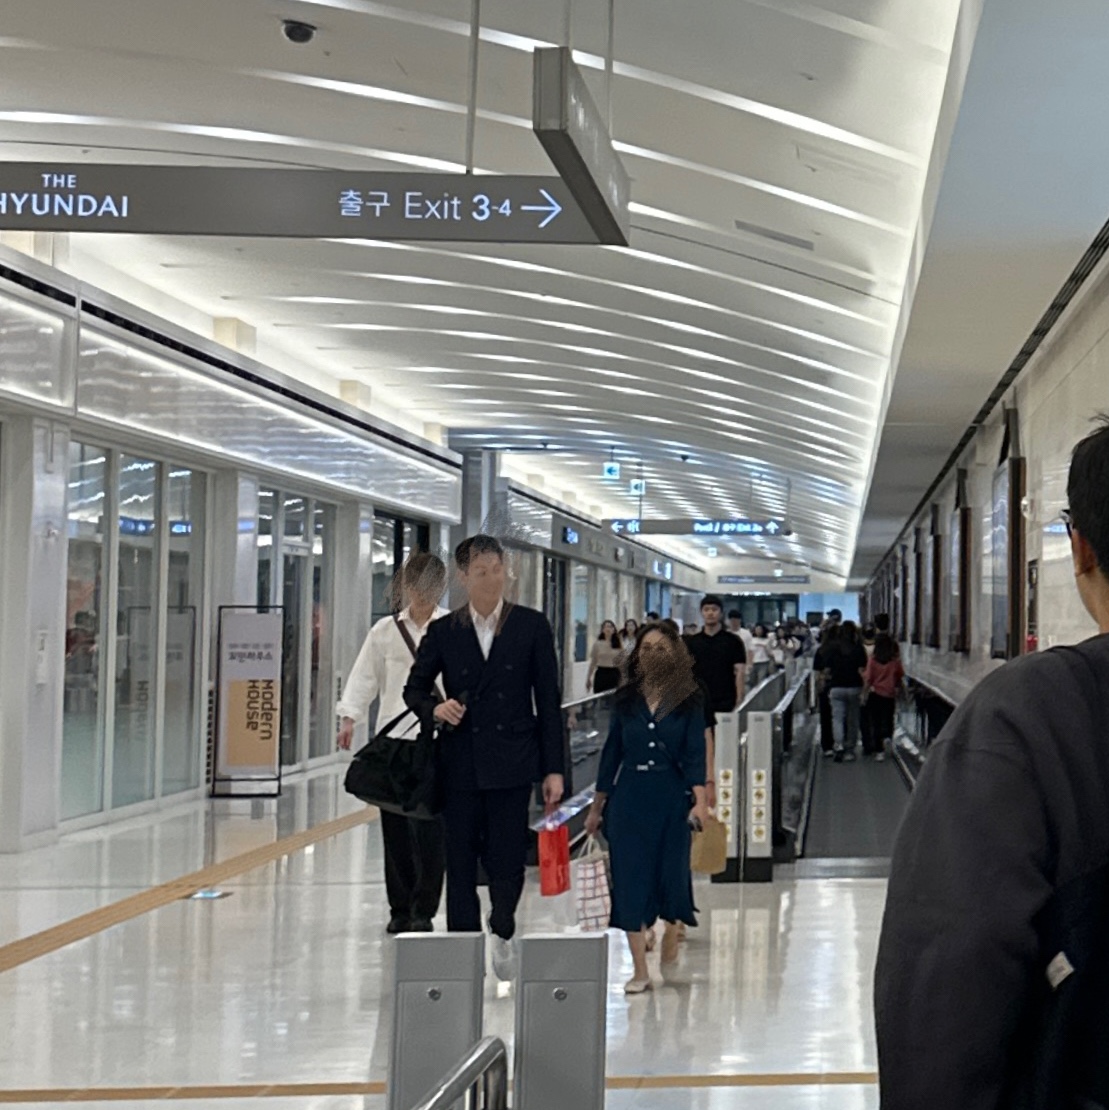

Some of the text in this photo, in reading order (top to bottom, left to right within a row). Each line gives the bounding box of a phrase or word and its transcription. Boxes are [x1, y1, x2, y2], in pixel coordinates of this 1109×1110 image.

[41, 173, 77, 188] THE
[338, 189, 512, 221] 출구 Exit 3-4
